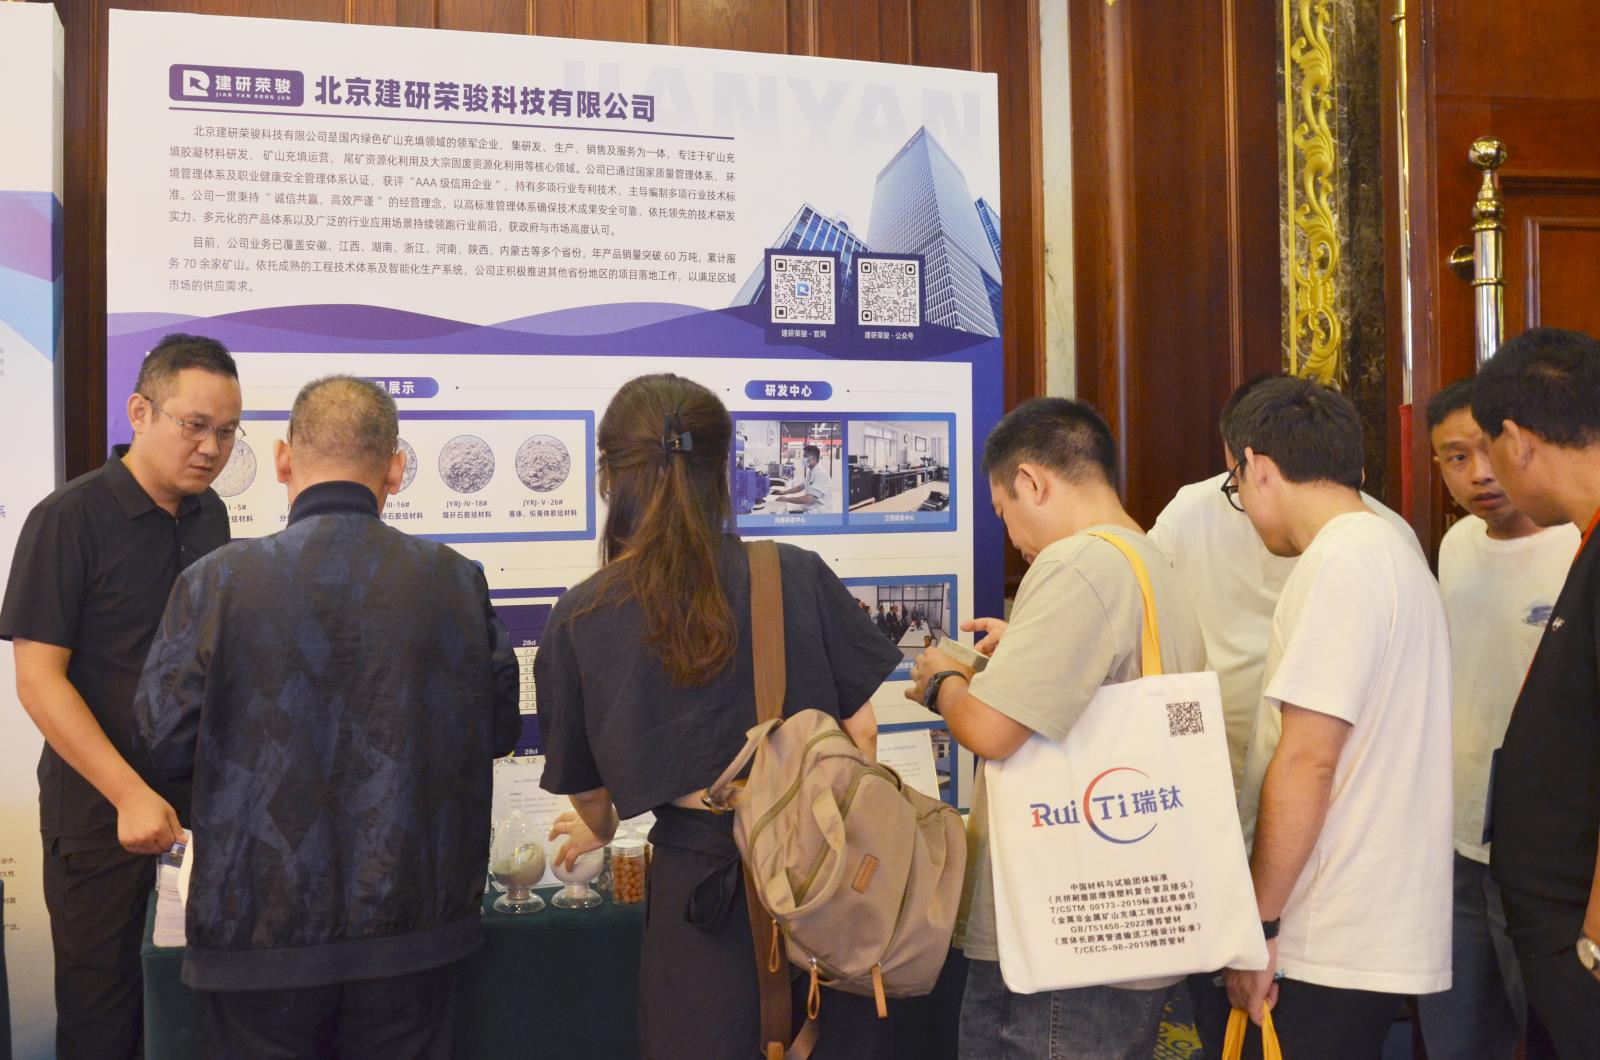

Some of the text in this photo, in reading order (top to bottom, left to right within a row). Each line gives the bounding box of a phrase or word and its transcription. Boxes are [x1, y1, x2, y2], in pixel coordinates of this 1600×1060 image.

[215, 75, 291, 94] 建研荣骏
[315, 75, 655, 122] 北京建研荣骏科技有限公司
[169, 279, 253, 292] 市场的供应需求。
[765, 384, 812, 398] 研发中心
[522, 639, 537, 647] 28d
[1030, 785, 1184, 828] Rui Ti 瑞钛
[1070, 873, 1168, 891] 中国材料与试验团体标准
